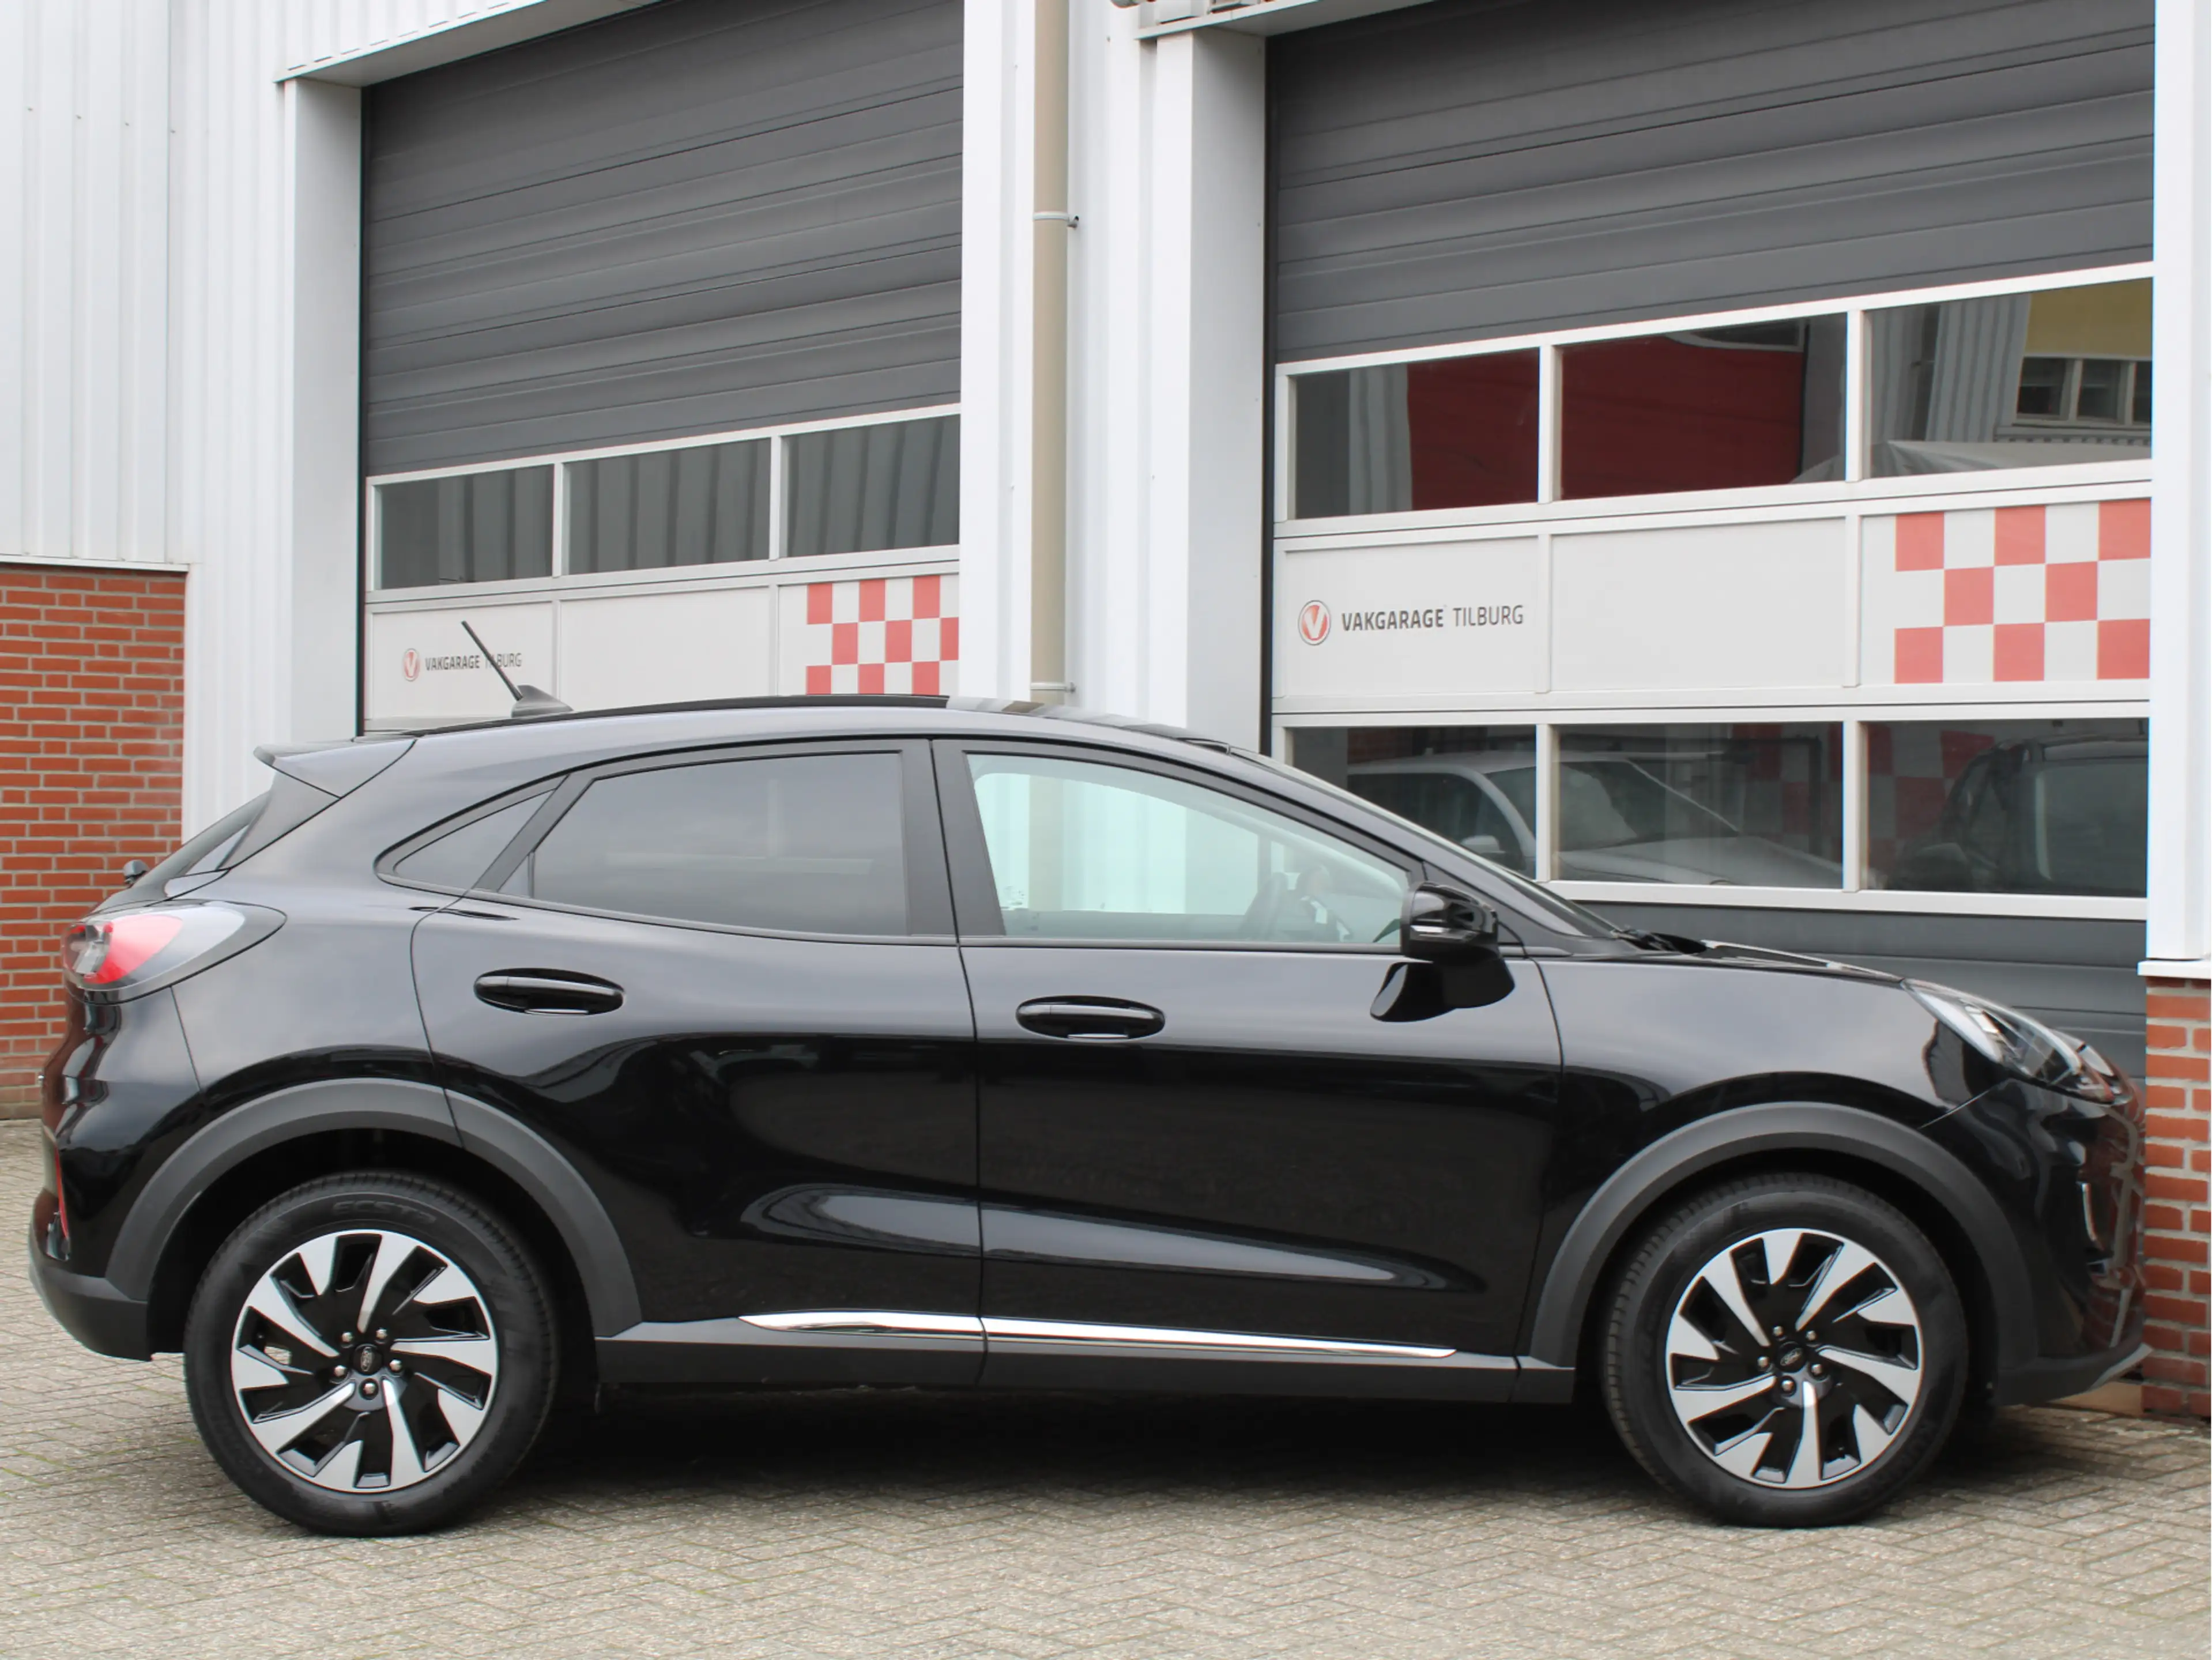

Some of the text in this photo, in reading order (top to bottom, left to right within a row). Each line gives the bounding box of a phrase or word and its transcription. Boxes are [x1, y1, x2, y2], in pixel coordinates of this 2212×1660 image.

[1341, 604, 1524, 631] VAKGARAGE TILBURG
[424, 652, 522, 671] VAKGARAGE TBURG
